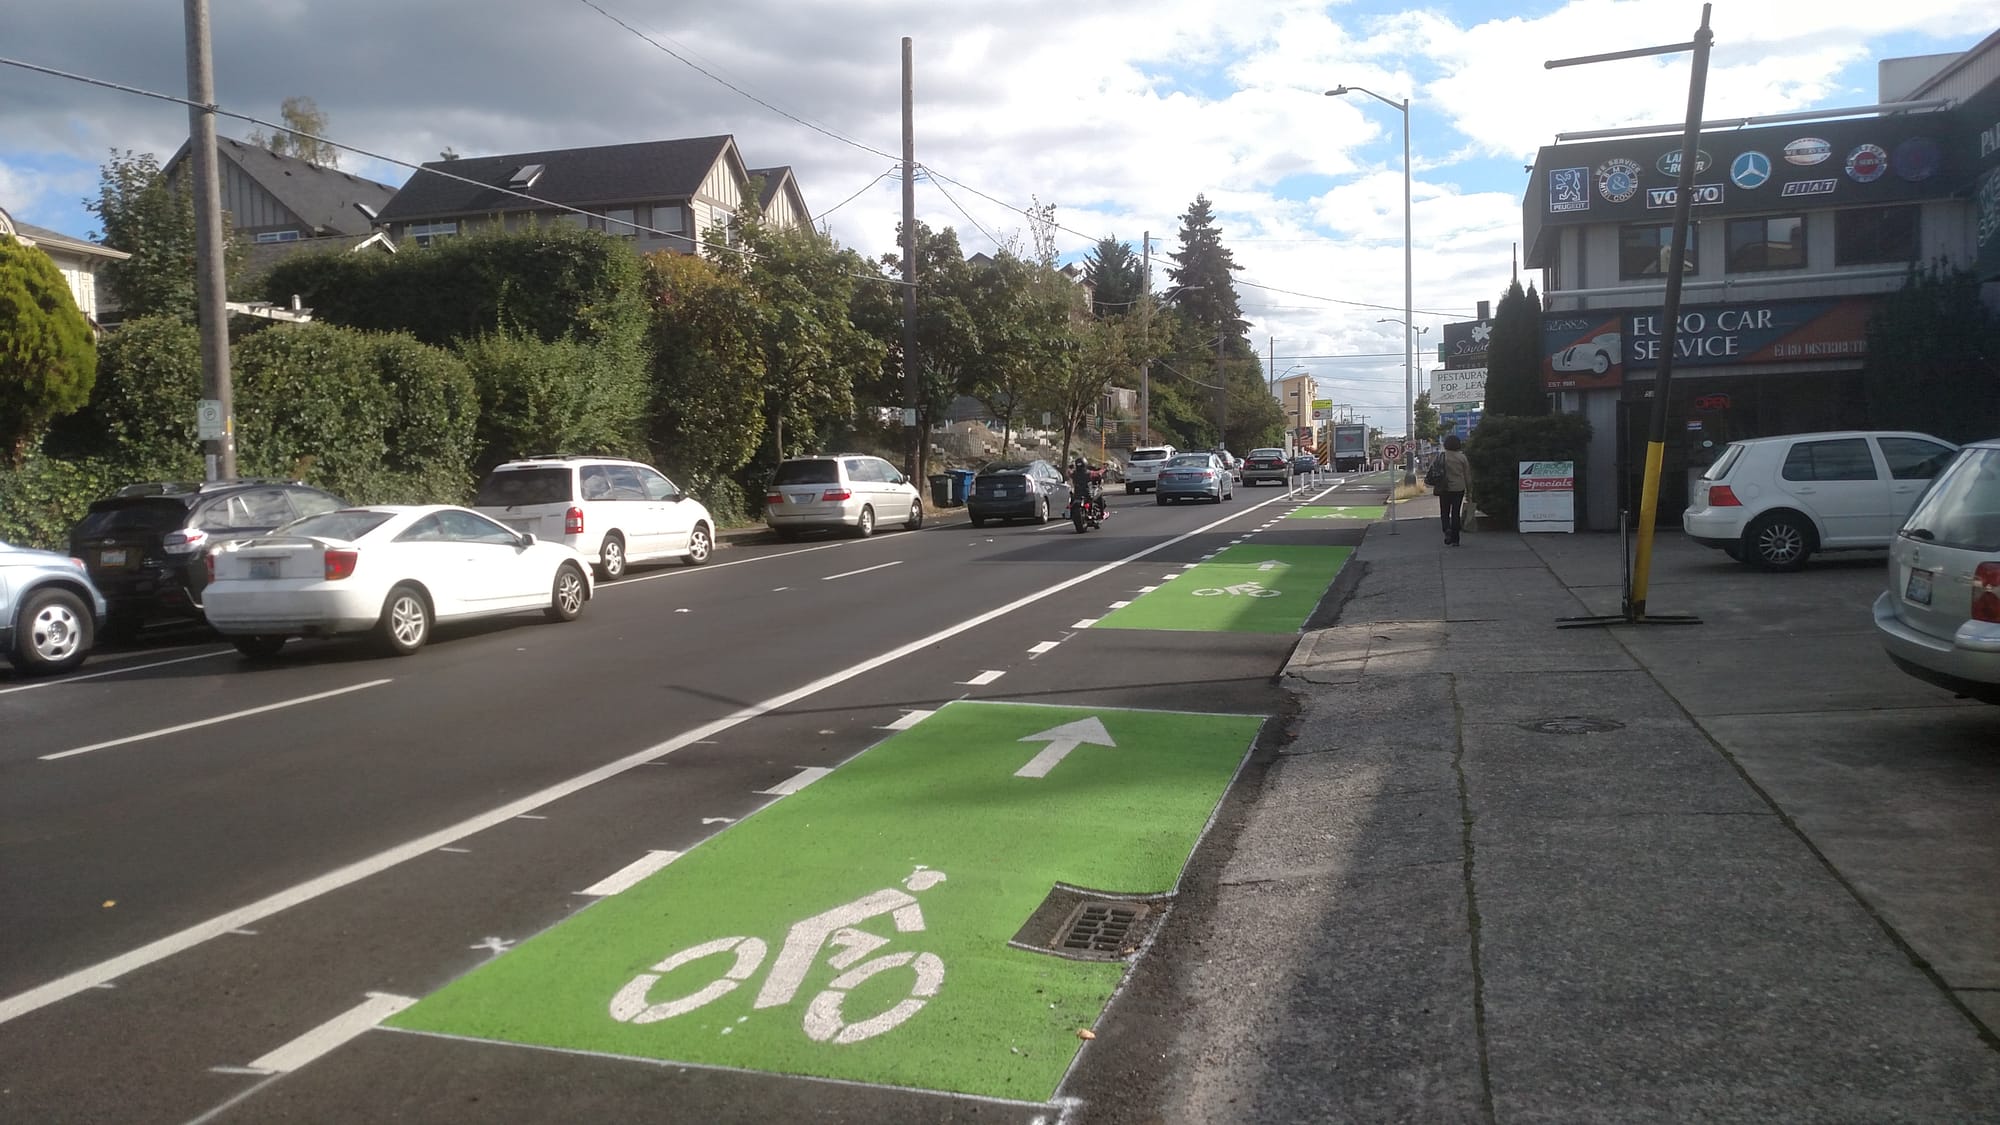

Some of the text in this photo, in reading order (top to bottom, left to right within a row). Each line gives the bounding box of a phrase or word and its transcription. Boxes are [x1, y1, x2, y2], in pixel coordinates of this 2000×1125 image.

[1603, 166, 1632, 178] BMW
[1608, 158, 1641, 173] SERVICE
[1786, 181, 1834, 195] FIAT
[1651, 187, 1718, 205] VOVO
[1717, 309, 1773, 331] CAR
[1634, 336, 1738, 360] SEVICE
[1774, 344, 1802, 357] EURO
[1437, 371, 1488, 382] RESTAURAN
[1440, 383, 1458, 391] FOR
[1521, 478, 1573, 489] Specials
